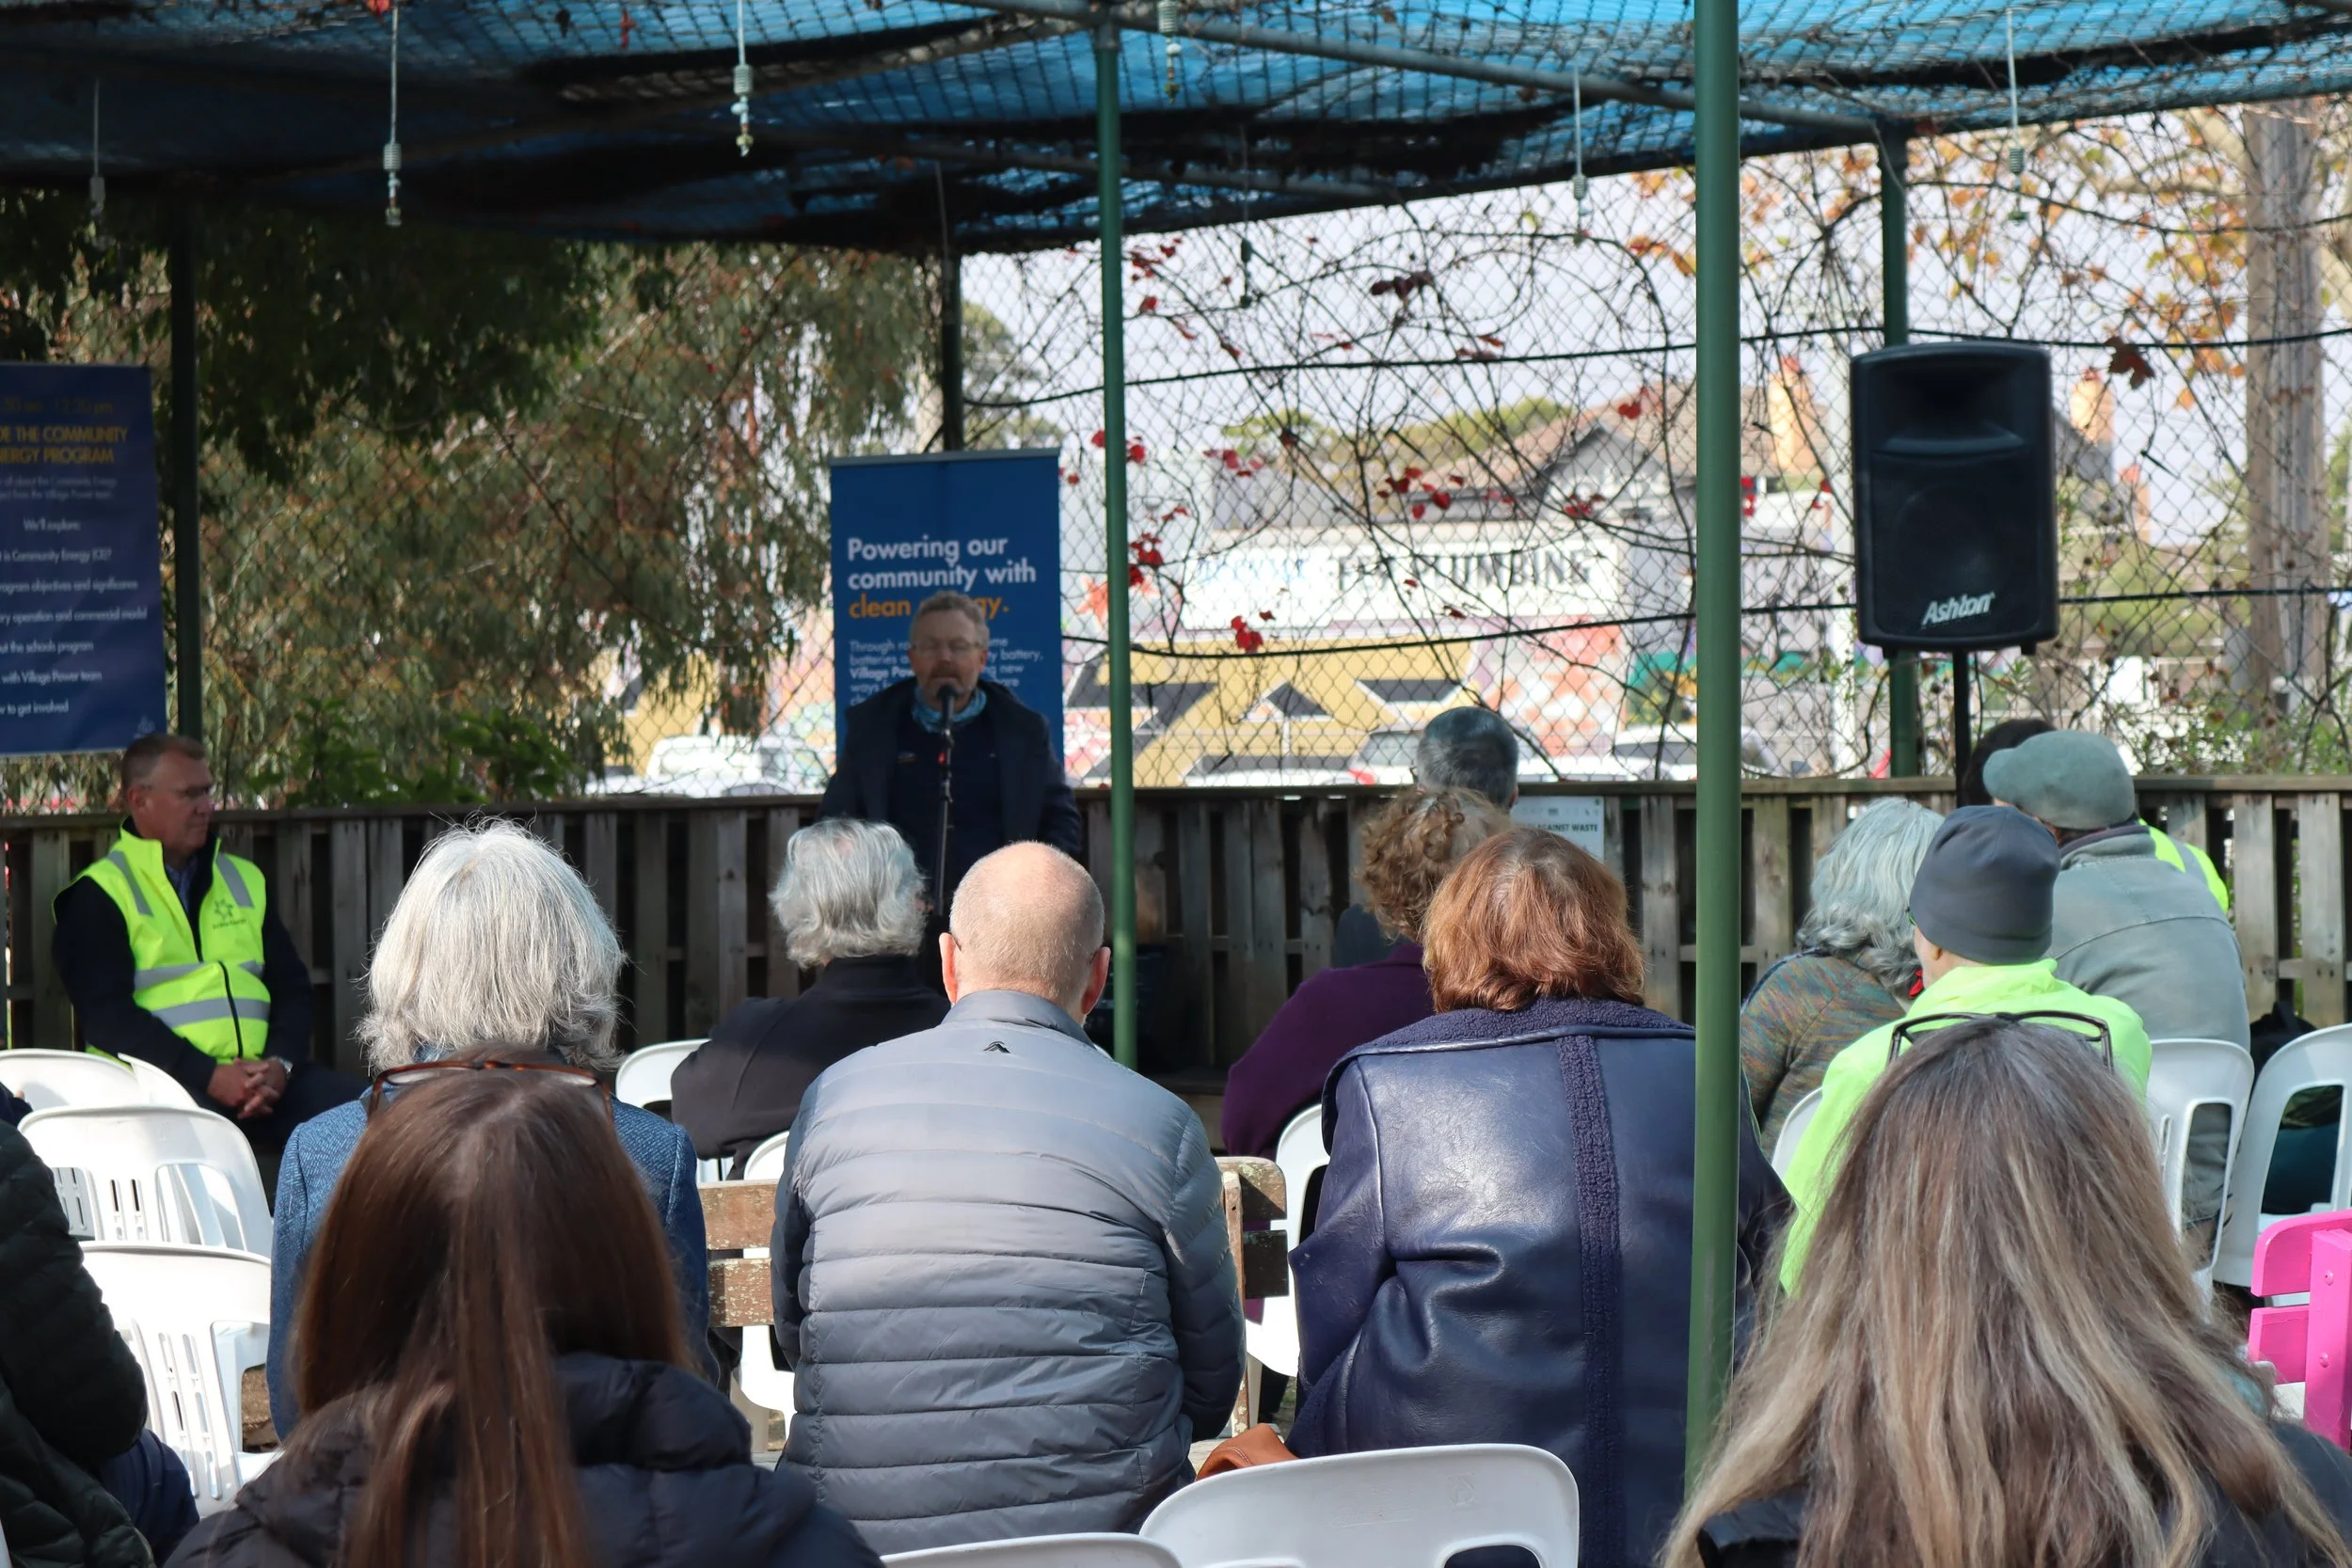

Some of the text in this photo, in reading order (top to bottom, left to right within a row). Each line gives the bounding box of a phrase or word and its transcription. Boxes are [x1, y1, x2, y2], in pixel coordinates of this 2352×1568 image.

[16, 425, 40, 443] THE
[43, 425, 129, 443] COMMUNITY
[0, 447, 115, 464] ERGY PROGRAM
[848, 533, 1009, 567] Powering our
[848, 556, 1037, 592] community with
[73, 576, 91, 592] and
[850, 593, 911, 618] clean
[1920, 591, 1995, 627] Ashton
[55, 606, 72, 623] and
[9, 639, 24, 654] the
[57, 641, 95, 656] program
[850, 638, 896, 655] Through
[1000, 646, 1044, 663] battery,
[850, 654, 898, 667] batteries
[999, 664, 1025, 674] new
[1, 670, 21, 684] with
[22, 668, 51, 686] Village
[52, 668, 80, 683] Power
[850, 666, 914, 682] Village Pow
[850, 684, 880, 696] ways
[7, 702, 17, 715] to
[18, 702, 32, 719] get
[33, 698, 70, 714] involved
[1571, 823, 1598, 832] WASTE
